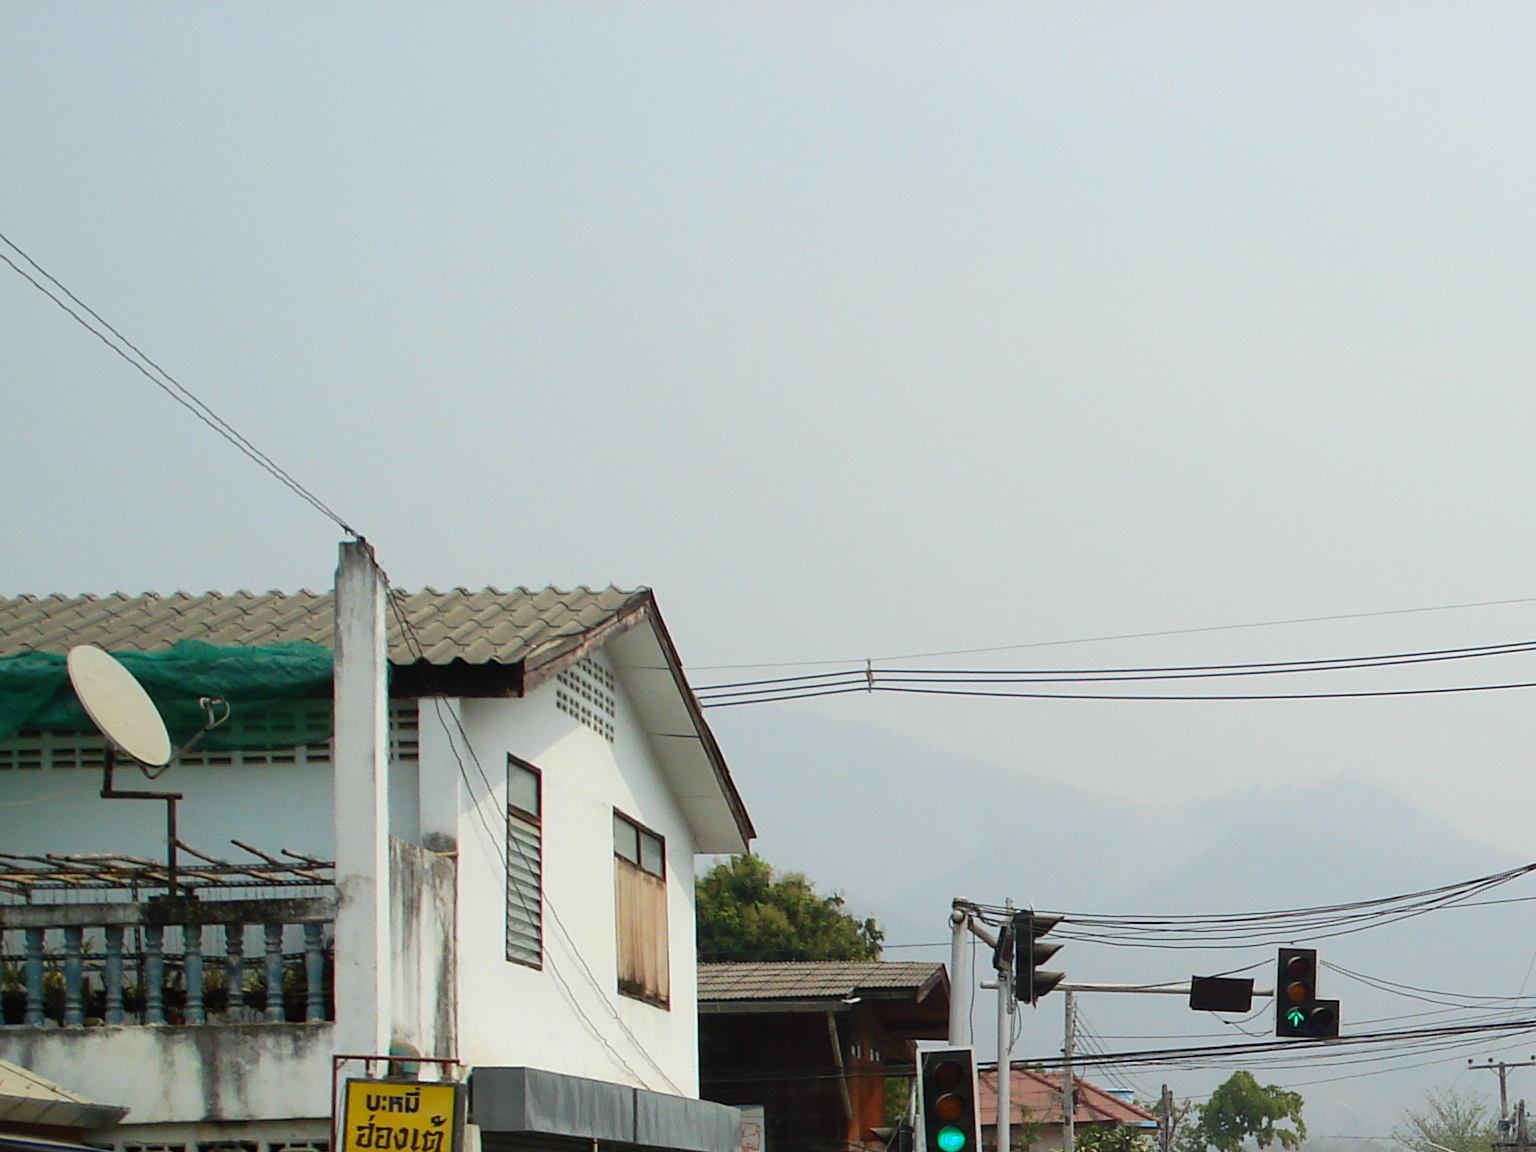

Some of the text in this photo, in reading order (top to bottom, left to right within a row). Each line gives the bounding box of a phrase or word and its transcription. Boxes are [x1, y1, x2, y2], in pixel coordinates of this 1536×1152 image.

[366, 1087, 421, 1113] บะหมี่
[355, 1115, 447, 1152] ฮ่องเต้
